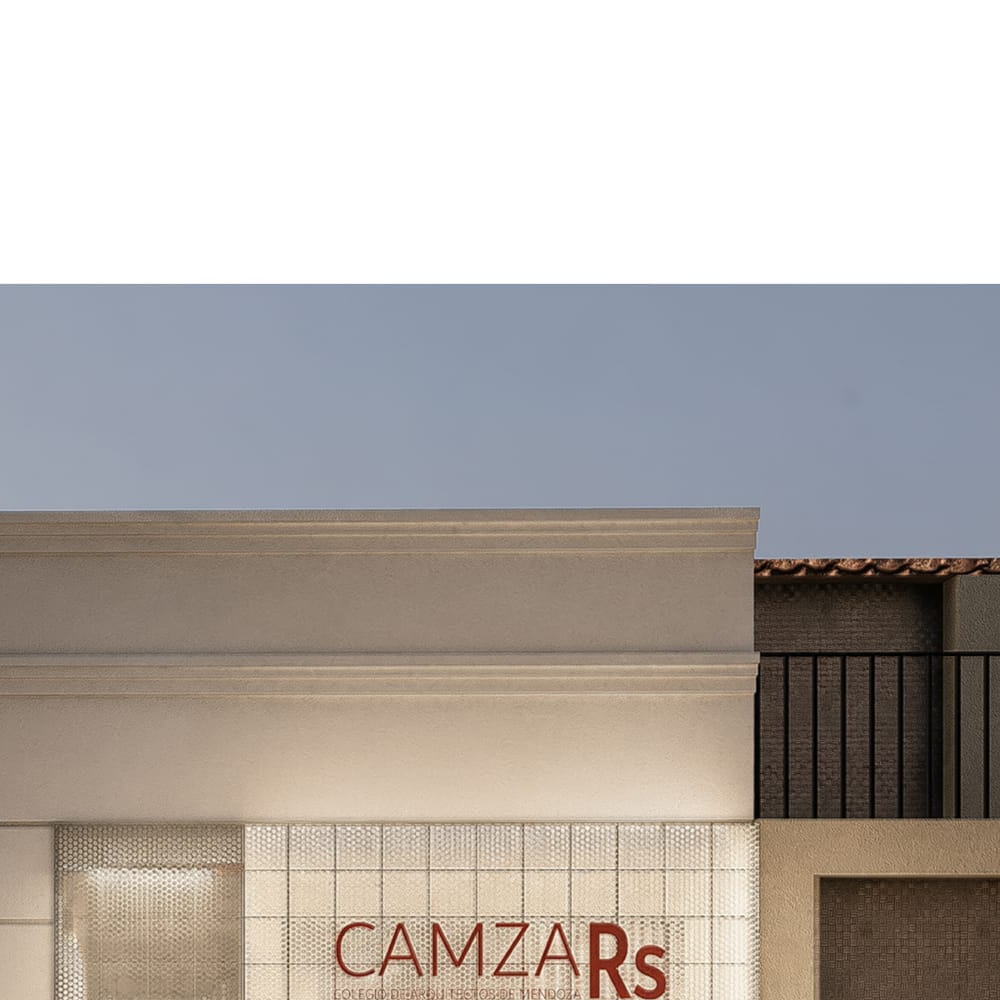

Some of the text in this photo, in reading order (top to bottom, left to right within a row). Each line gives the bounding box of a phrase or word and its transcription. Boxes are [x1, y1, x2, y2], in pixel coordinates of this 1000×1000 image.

[335, 921, 667, 1000] CAMZARs
[334, 988, 386, 1000] COLEGIO
[520, 988, 582, 1000] MENDOZA
